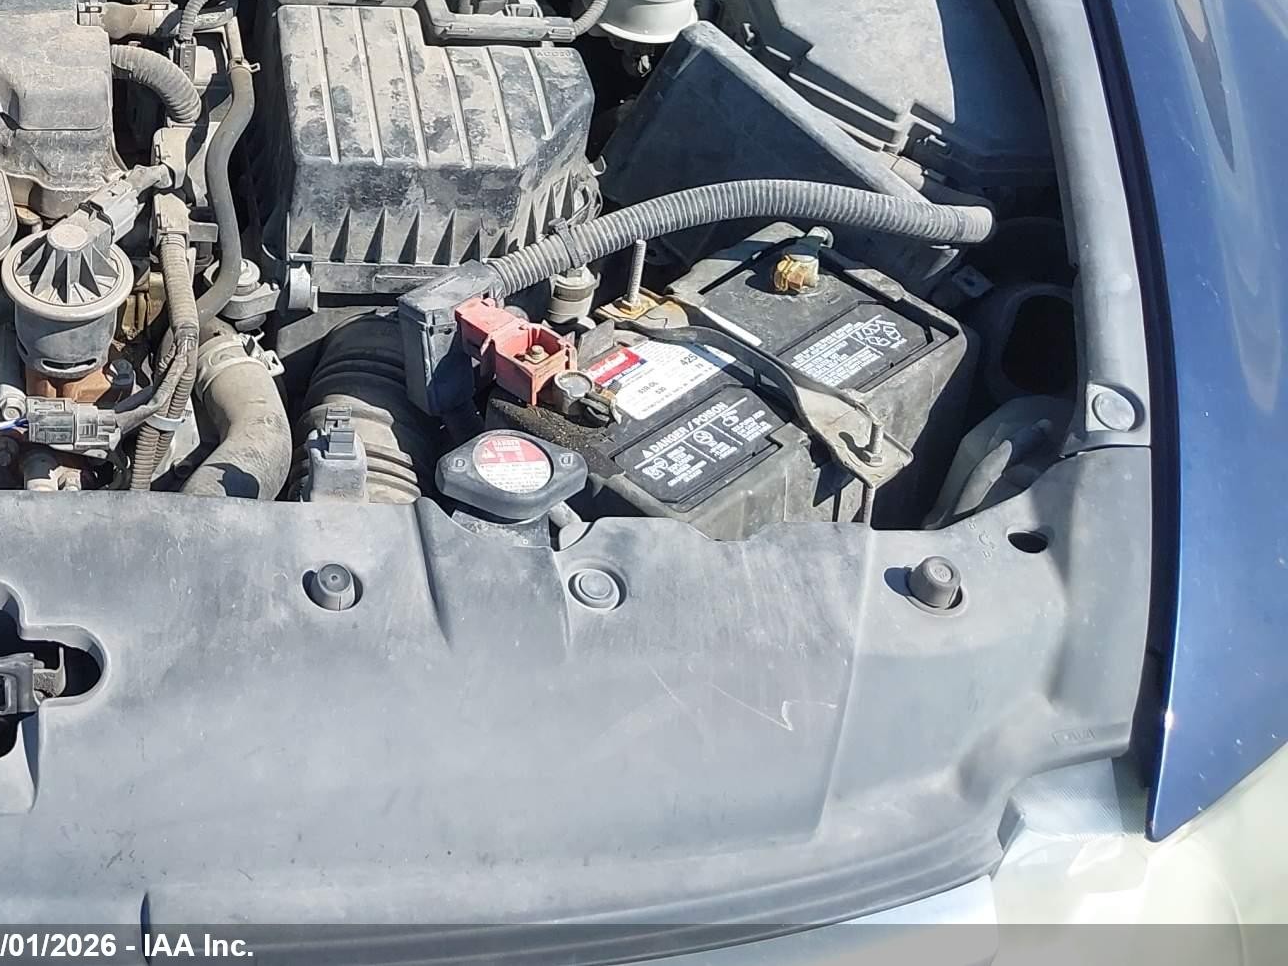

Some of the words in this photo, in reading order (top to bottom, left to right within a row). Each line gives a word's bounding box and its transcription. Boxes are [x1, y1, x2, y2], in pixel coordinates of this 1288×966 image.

[679, 352, 698, 366] 425
[648, 425, 690, 453] DANGER
[691, 401, 729, 426] POISON
